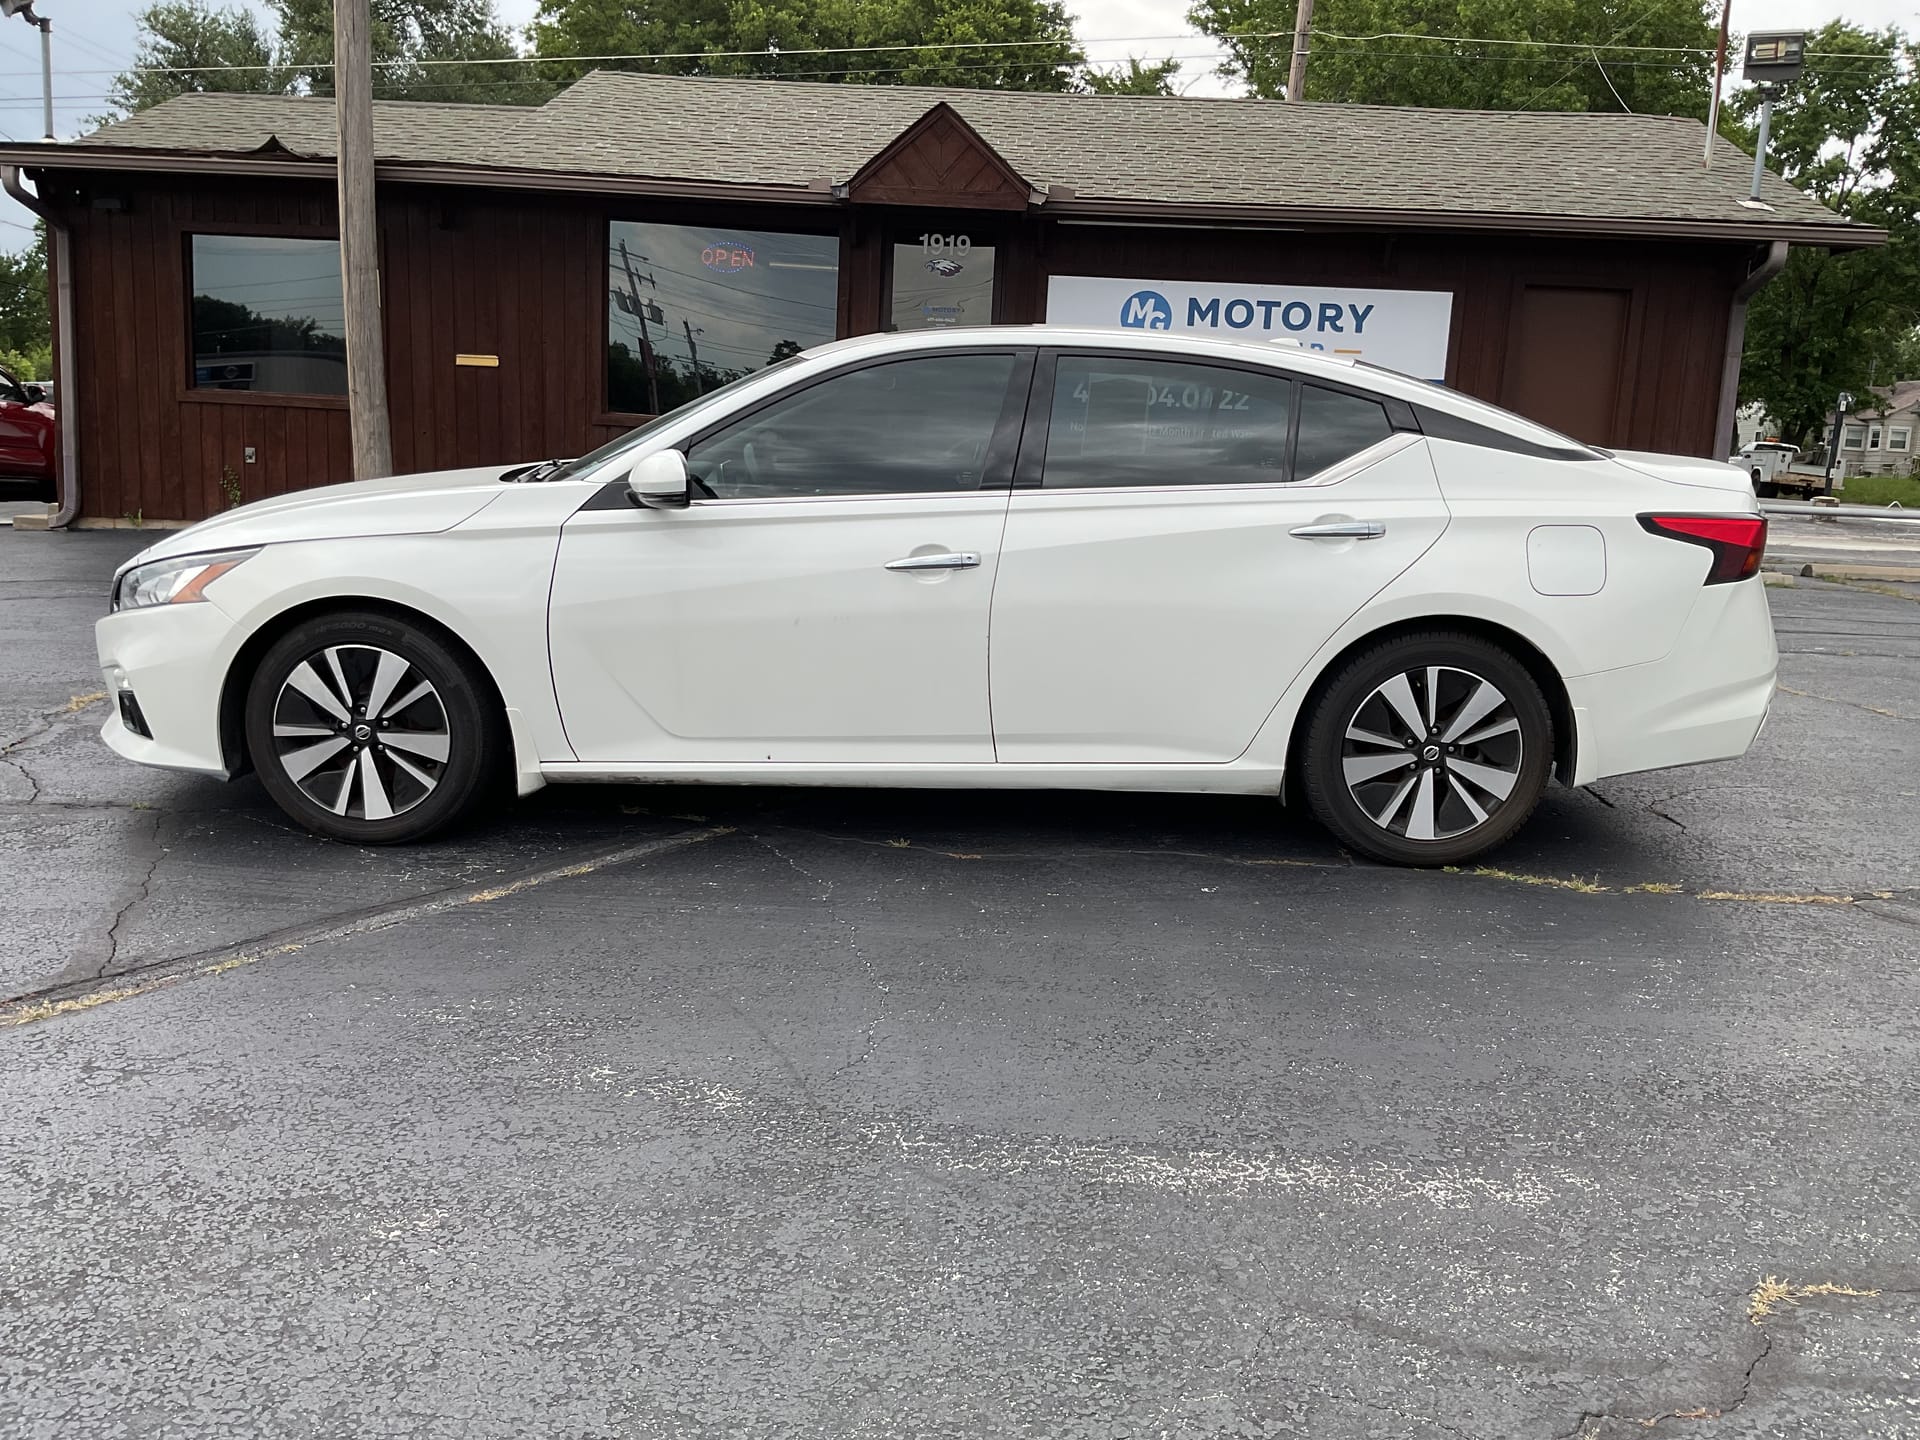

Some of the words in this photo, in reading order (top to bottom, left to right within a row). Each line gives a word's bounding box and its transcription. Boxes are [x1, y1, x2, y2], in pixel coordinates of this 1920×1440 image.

[919, 233, 971, 257] 1919
[702, 249, 754, 267] OPEN
[1187, 297, 1375, 333] MOTORY
